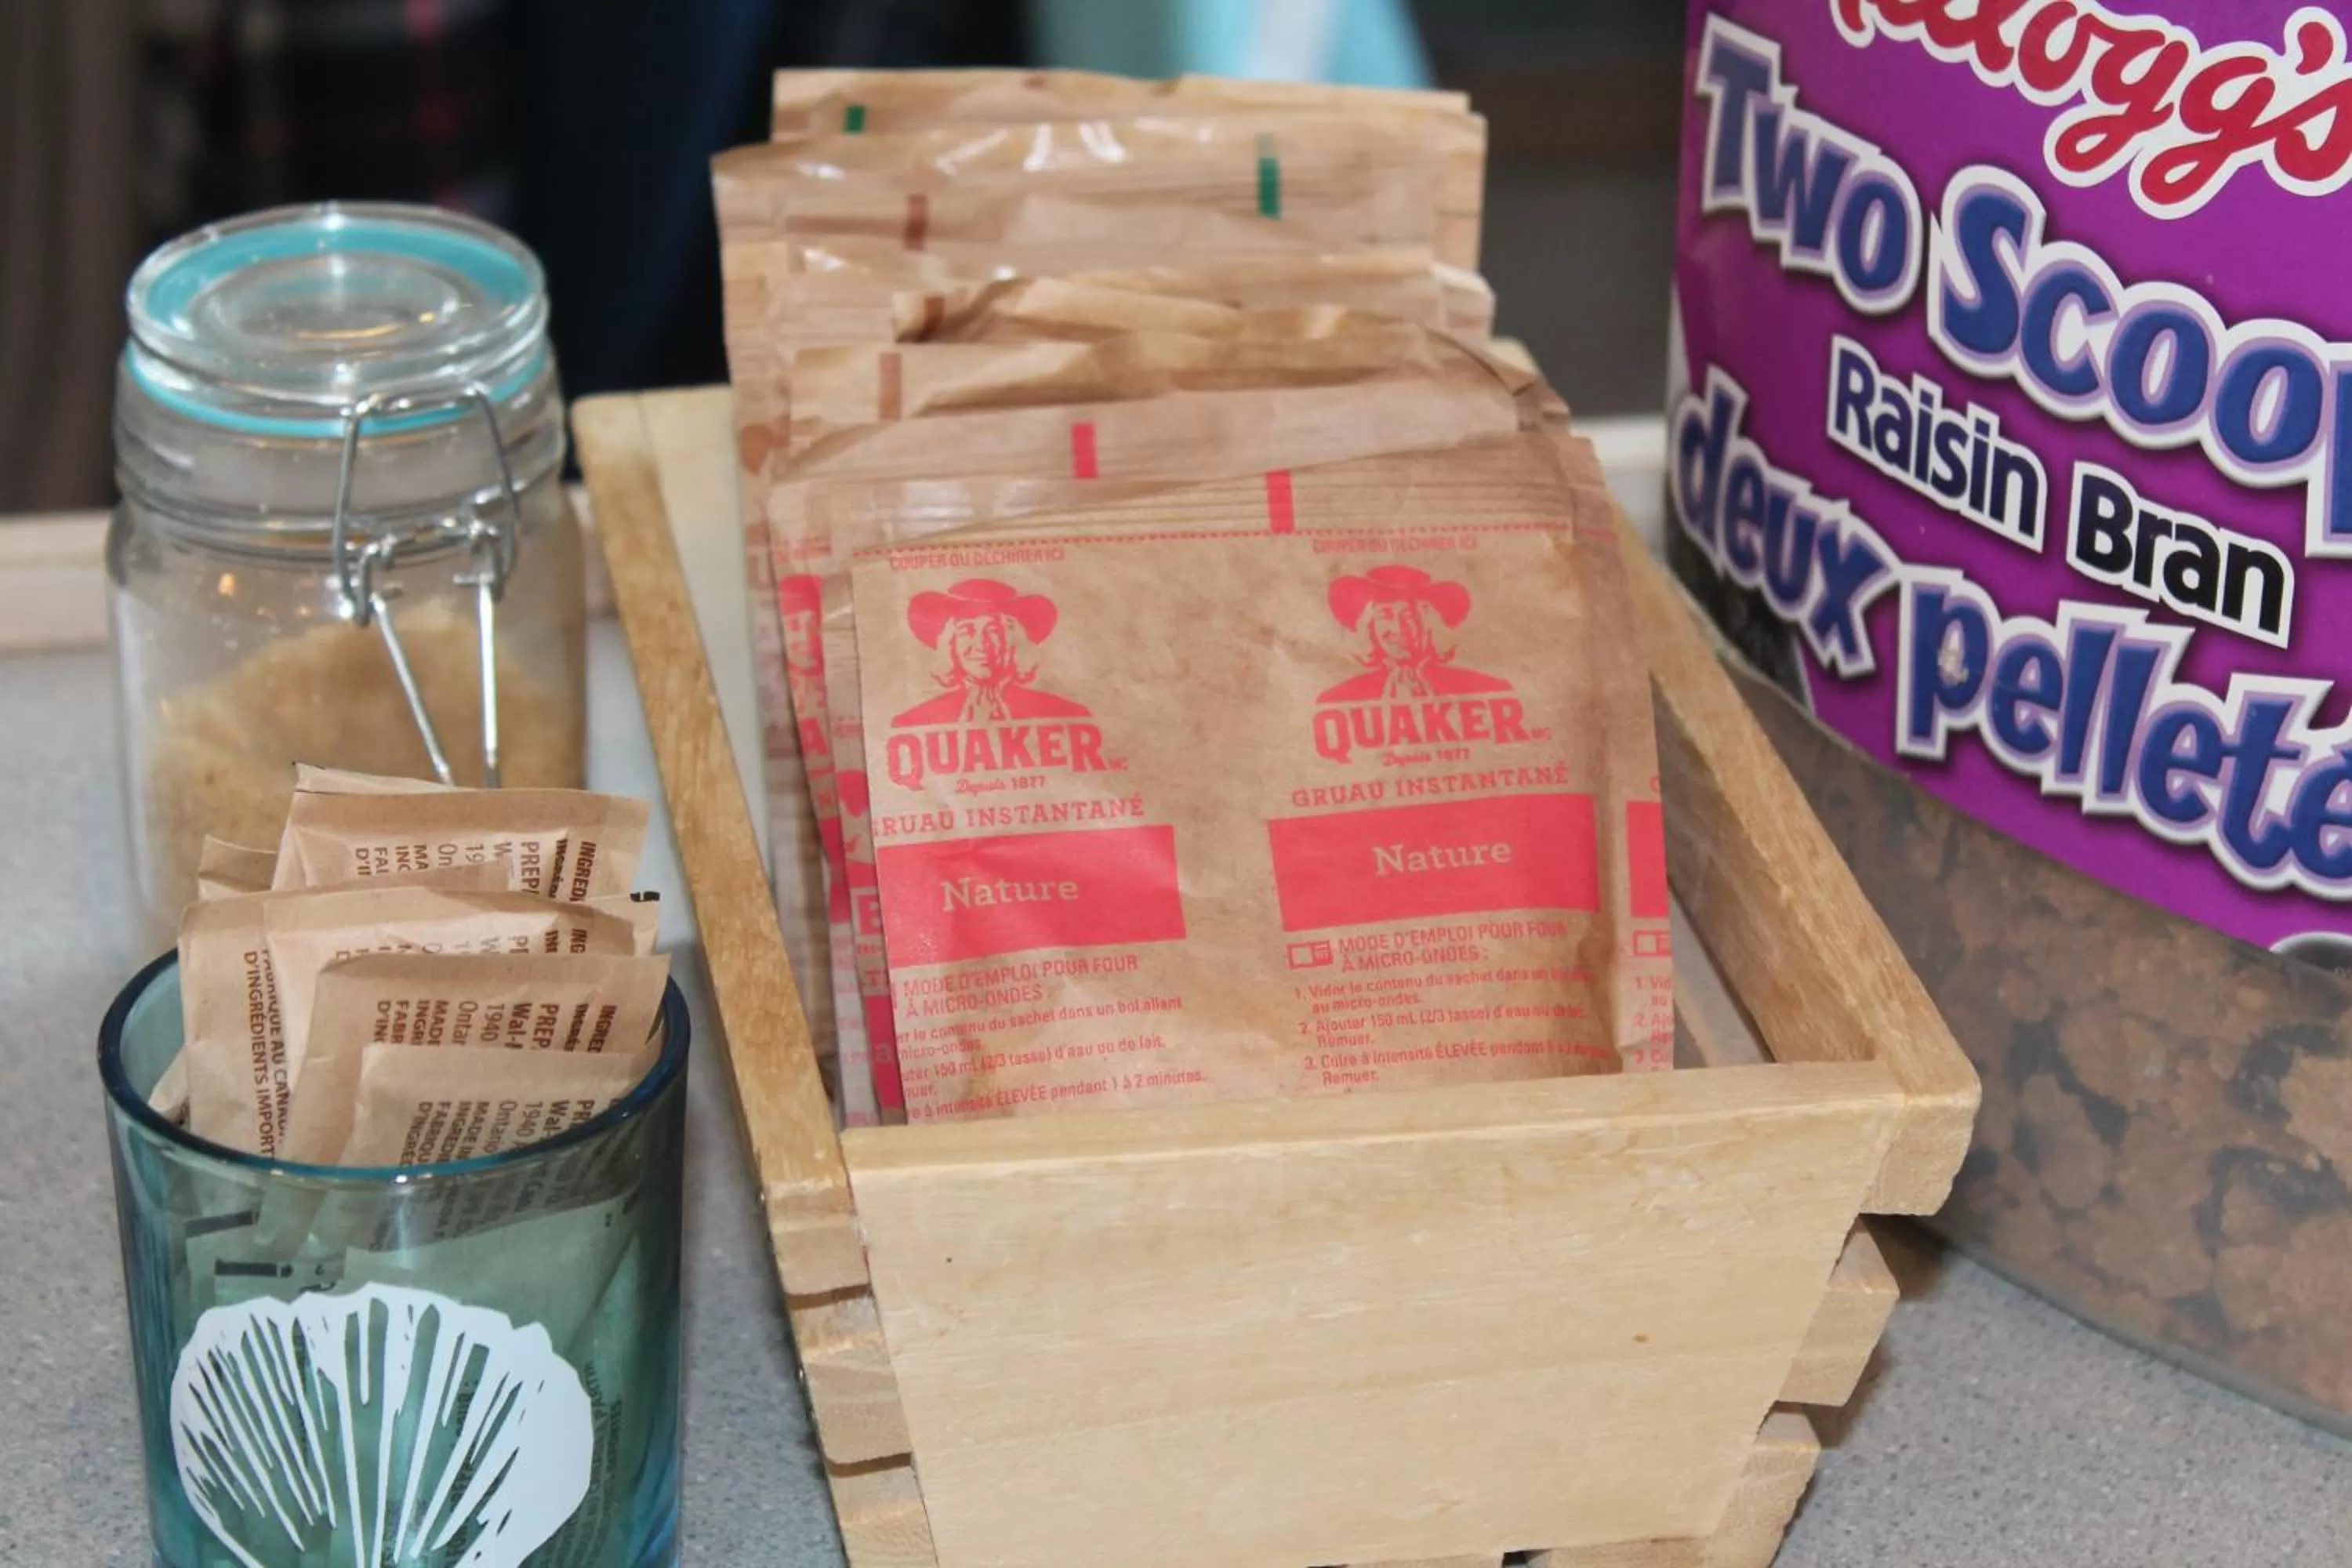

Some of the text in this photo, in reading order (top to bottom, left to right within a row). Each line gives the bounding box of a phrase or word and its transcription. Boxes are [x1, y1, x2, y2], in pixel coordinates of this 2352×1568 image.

[1706, 34, 2352, 541] Two Scoo
[1835, 347, 2288, 633] Raisin Bran
[1678, 390, 1891, 663] deux
[1313, 697, 1532, 765] QUAKER
[886, 723, 1107, 791] QUAKER
[955, 775, 1047, 797] Depuis 1877
[1291, 759, 1569, 808] GRUAU INSTANTANÉ
[964, 792, 1145, 829] INSTANTANÉ
[1373, 841, 1513, 878] Nature
[941, 875, 1080, 913] Nature
[1338, 933, 1391, 954] MODE
[1392, 924, 1474, 949] D'EMPLOI
[1478, 920, 1525, 940] POUR
[958, 963, 1038, 990] D'EMPLOI
[1042, 957, 1090, 978] POUR
[1093, 953, 1139, 974] FOUR
[1341, 951, 1356, 973] À
[1358, 944, 1481, 971] MICRO-ONDES
[243, 950, 269, 1085] D'INGRÉDIENTS
[923, 982, 1043, 1018] MICRO-ONDES
[480, 1003, 505, 1042] 1940
[270, 1040, 286, 1065] AU
[483, 1099, 518, 1154] Ontario
[515, 1100, 544, 1137] 1940
